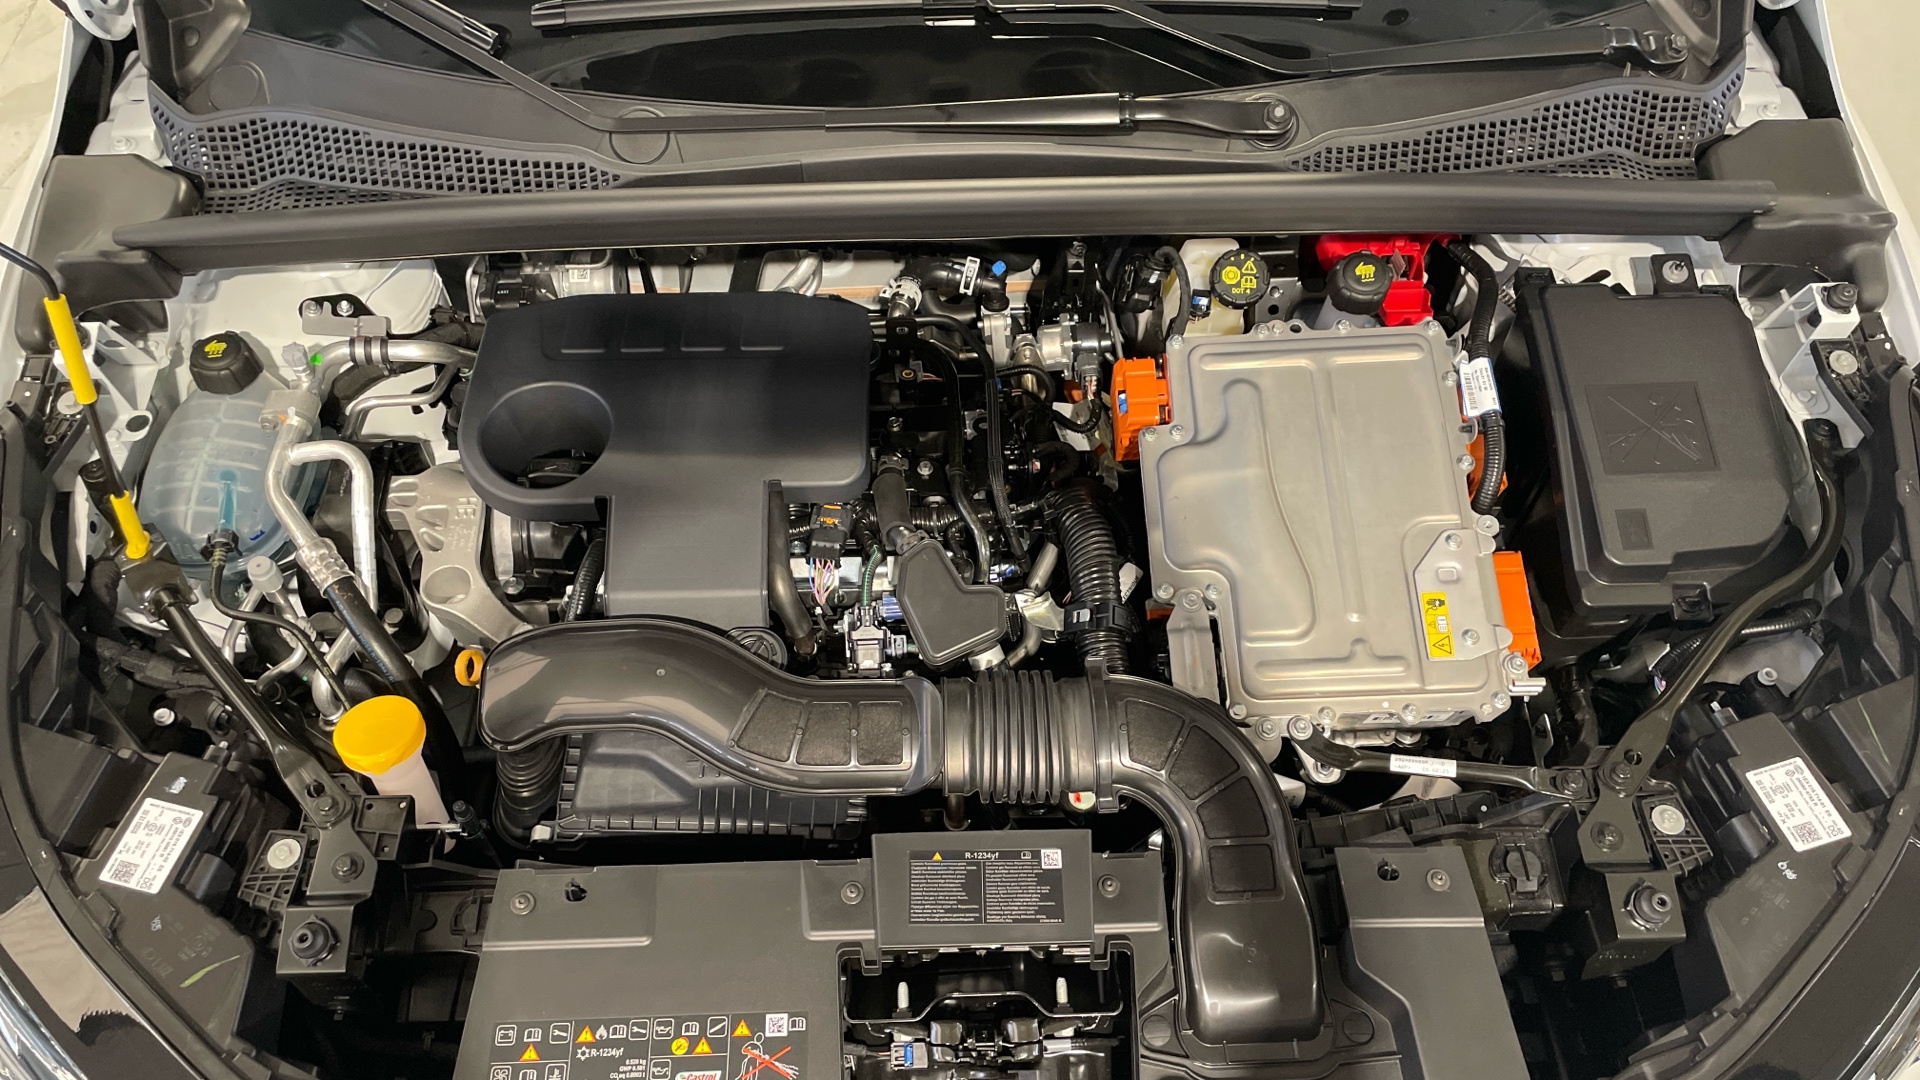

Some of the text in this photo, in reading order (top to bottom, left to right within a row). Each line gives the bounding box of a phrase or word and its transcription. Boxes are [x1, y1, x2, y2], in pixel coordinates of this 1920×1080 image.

[358, 633, 372, 653] HOSE
[1827, 824, 1839, 837] DG
[965, 851, 999, 860] R-1234yf
[140, 877, 151, 889] DG
[590, 1047, 624, 1059] R-1234yf
[686, 1072, 717, 1080] Castrol
